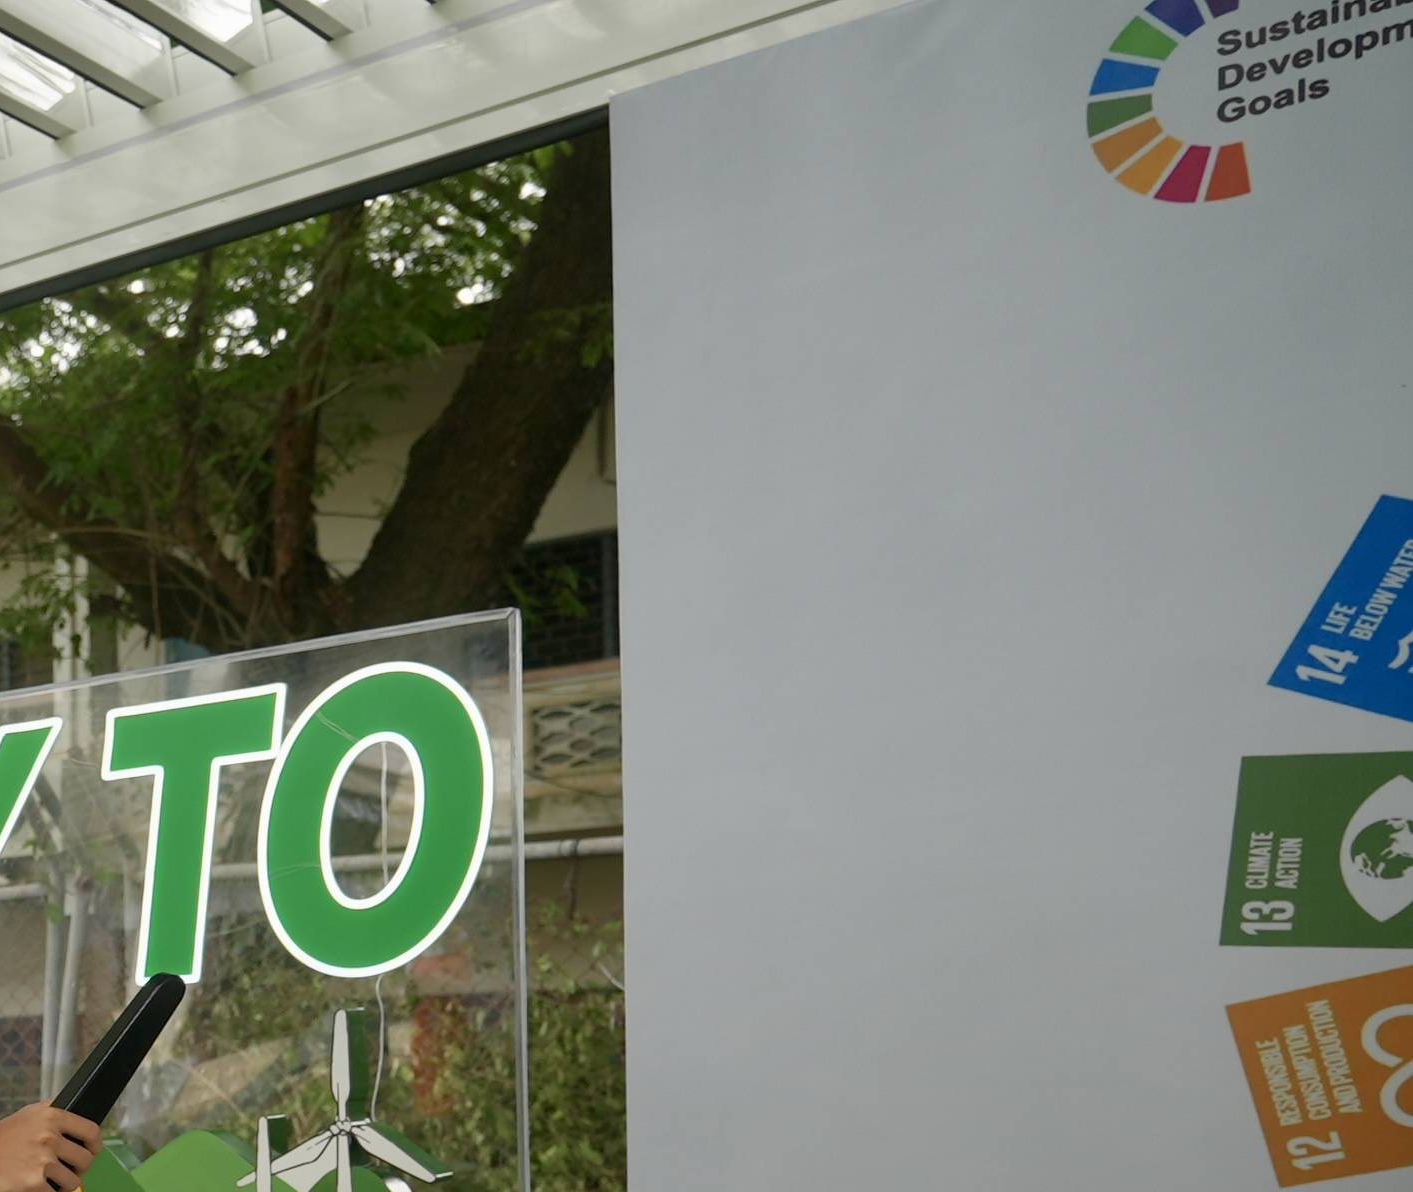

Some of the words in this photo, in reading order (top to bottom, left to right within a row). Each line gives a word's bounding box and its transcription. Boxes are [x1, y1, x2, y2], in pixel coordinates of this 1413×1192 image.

[1217, 0, 1413, 56] Sustaina
[1217, 78, 1330, 123] Goals
[1320, 602, 1358, 634] LIFE
[1349, 588, 1397, 641] BELOW
[1295, 644, 1360, 685] 14
[102, 661, 494, 986] TO
[1245, 831, 1274, 889] CLIMATE
[1275, 837, 1303, 889] ACTION
[1240, 900, 1295, 935] 13
[1305, 999, 1353, 1084] PRODUCTION
[1255, 1037, 1303, 1126] RESPONSIBLE
[1282, 1024, 1332, 1121] CONSUMPTION
[1332, 1083, 1363, 1113] AND
[1286, 1131, 1347, 1171] 12
